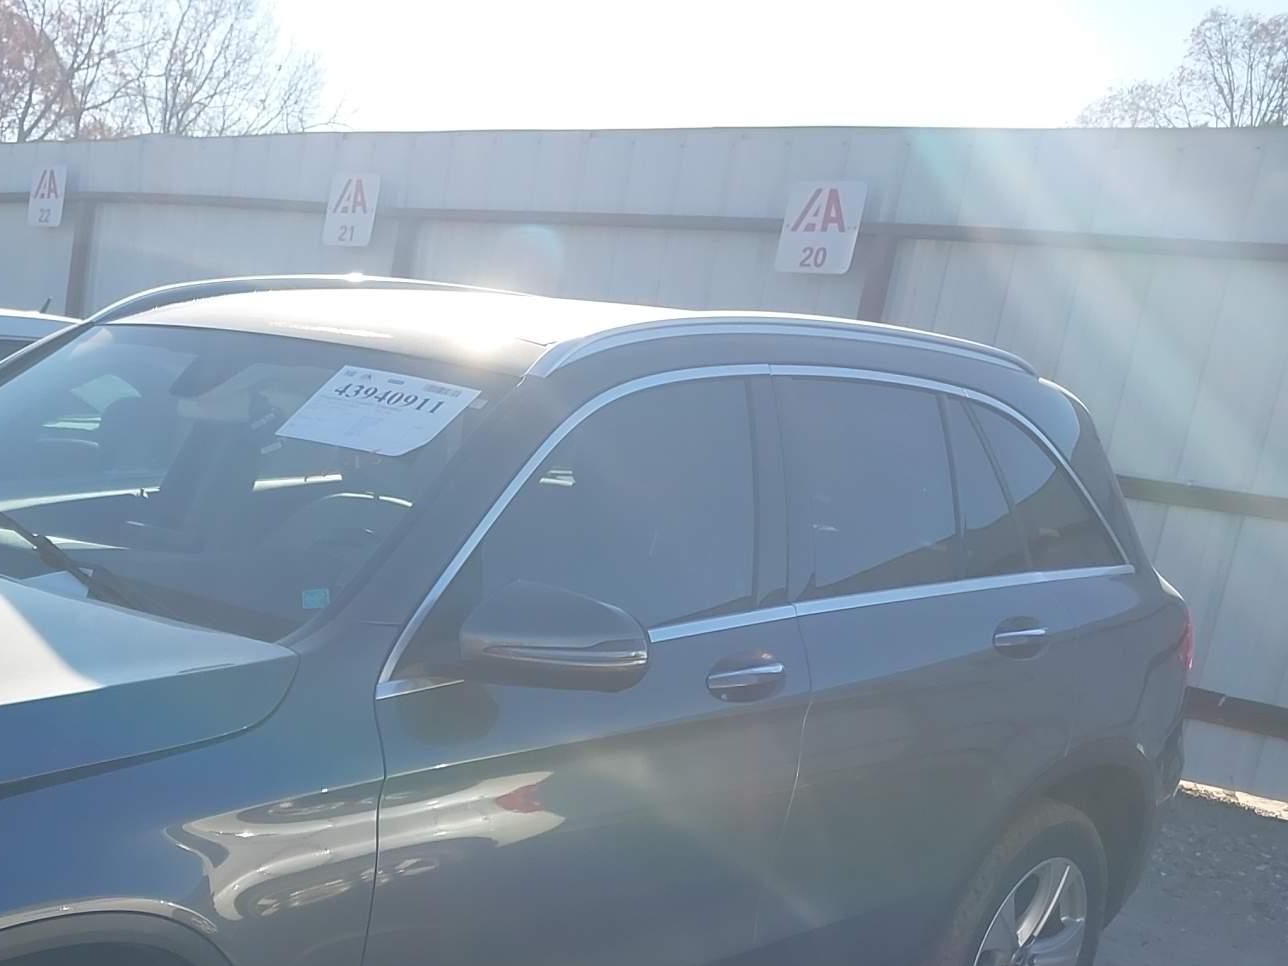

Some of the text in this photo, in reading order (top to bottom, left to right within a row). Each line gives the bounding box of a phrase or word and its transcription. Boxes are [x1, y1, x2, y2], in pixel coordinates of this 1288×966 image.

[337, 224, 355, 241] 21
[799, 246, 828, 267] 20
[334, 383, 445, 415] 43940911
